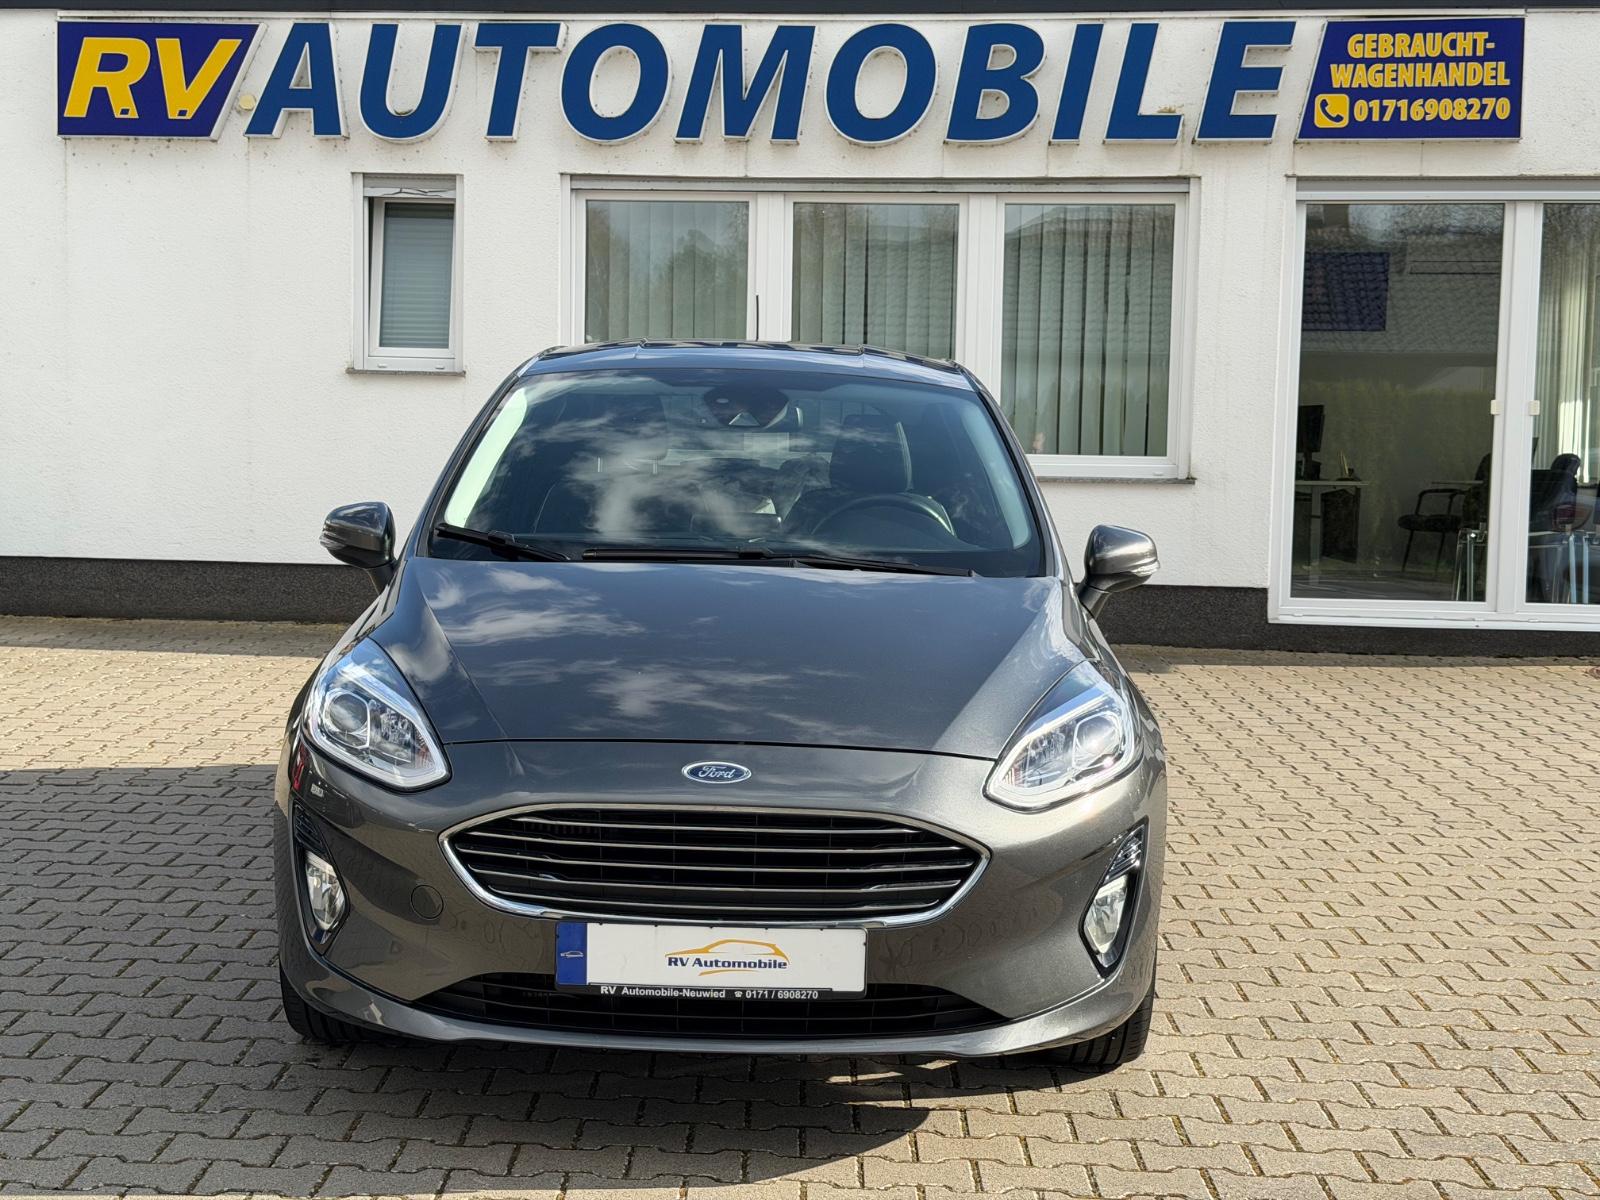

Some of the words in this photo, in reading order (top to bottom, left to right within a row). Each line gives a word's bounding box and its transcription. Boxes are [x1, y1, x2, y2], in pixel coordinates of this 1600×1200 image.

[1347, 31, 1495, 59] GEBRAUCHT-
[63, 37, 242, 119] RV
[244, 21, 1297, 141] AUTOMOBILE
[1330, 61, 1511, 88] WAGENHANDEL
[1353, 97, 1511, 122] 01716908270
[698, 765, 736, 778] Ford
[667, 957, 690, 967] RV
[692, 957, 787, 969] Automobile
[600, 985, 617, 995] RV
[621, 986, 726, 998] Automobile-Neuwied
